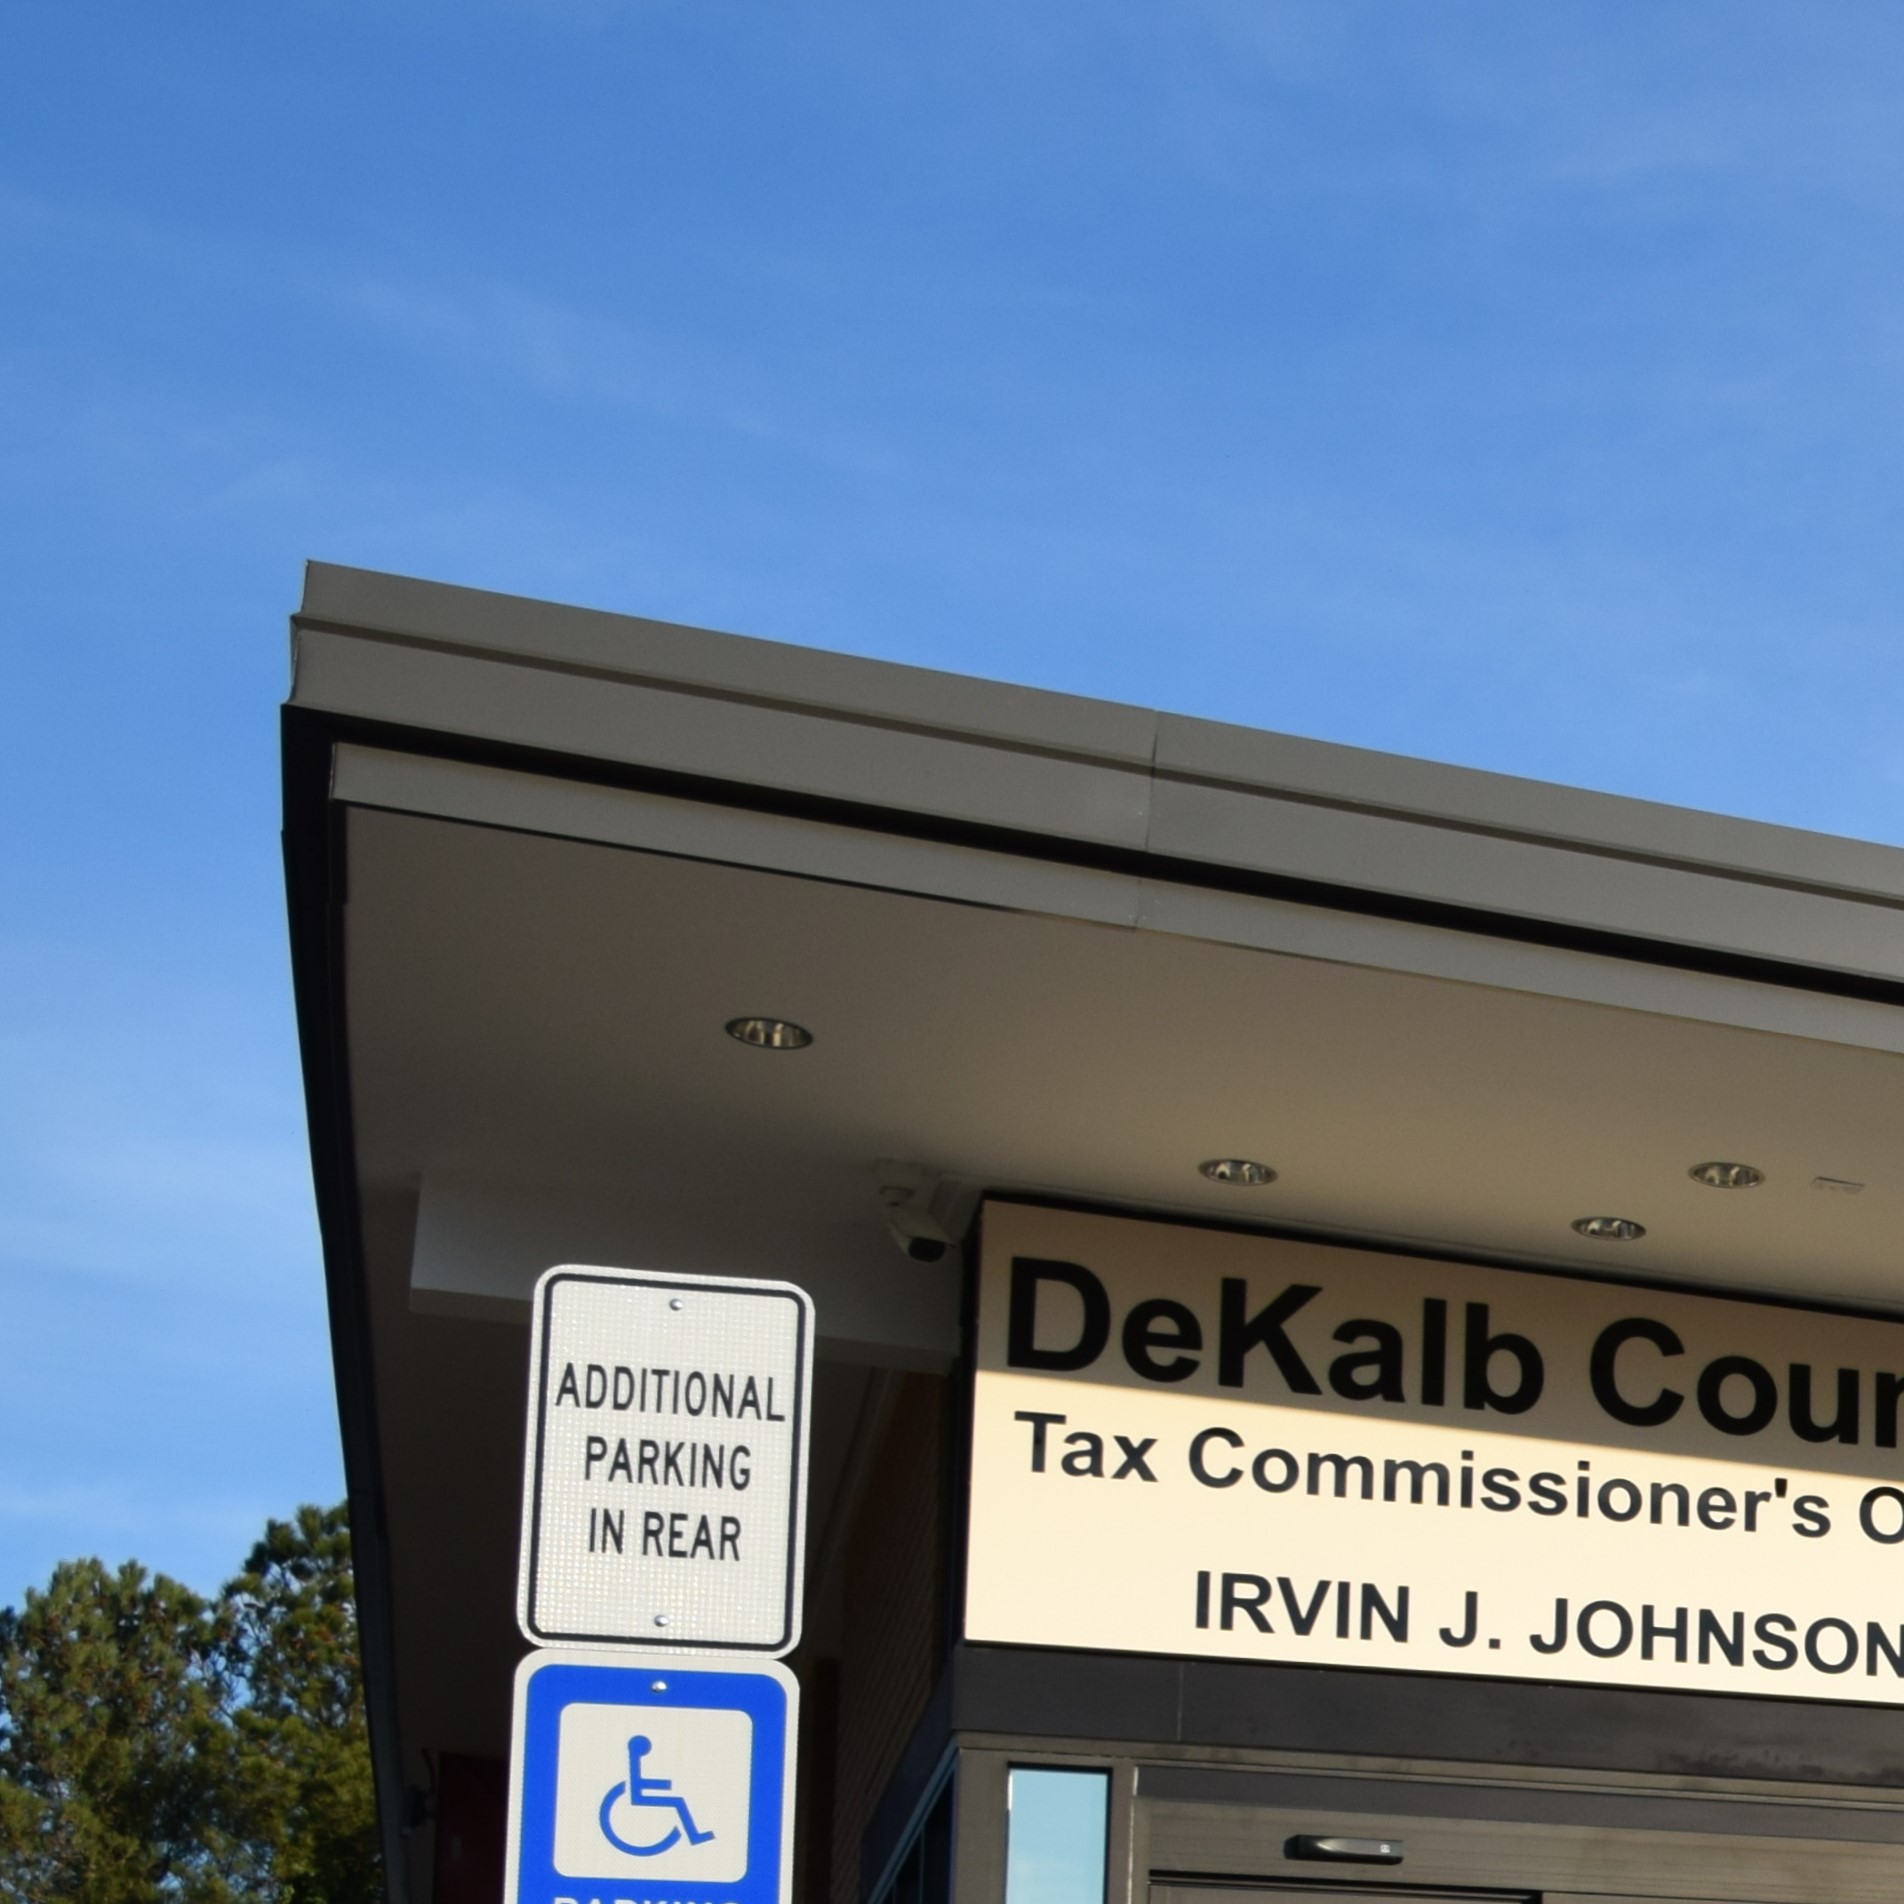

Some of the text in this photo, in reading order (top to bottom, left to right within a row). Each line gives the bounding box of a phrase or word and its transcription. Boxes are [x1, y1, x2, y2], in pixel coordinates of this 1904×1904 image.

[1006, 1256, 1546, 1416] DeKalb
[555, 1361, 786, 1423] ADDITIONAL
[584, 1435, 753, 1491] PARKING
[1013, 1410, 1158, 1483] Tax
[1187, 1425, 1833, 1539] Commissioner's
[588, 1510, 742, 1563] IN REAR
[1193, 1569, 1413, 1645] IRVIN
[1439, 1589, 1503, 1650] J.
